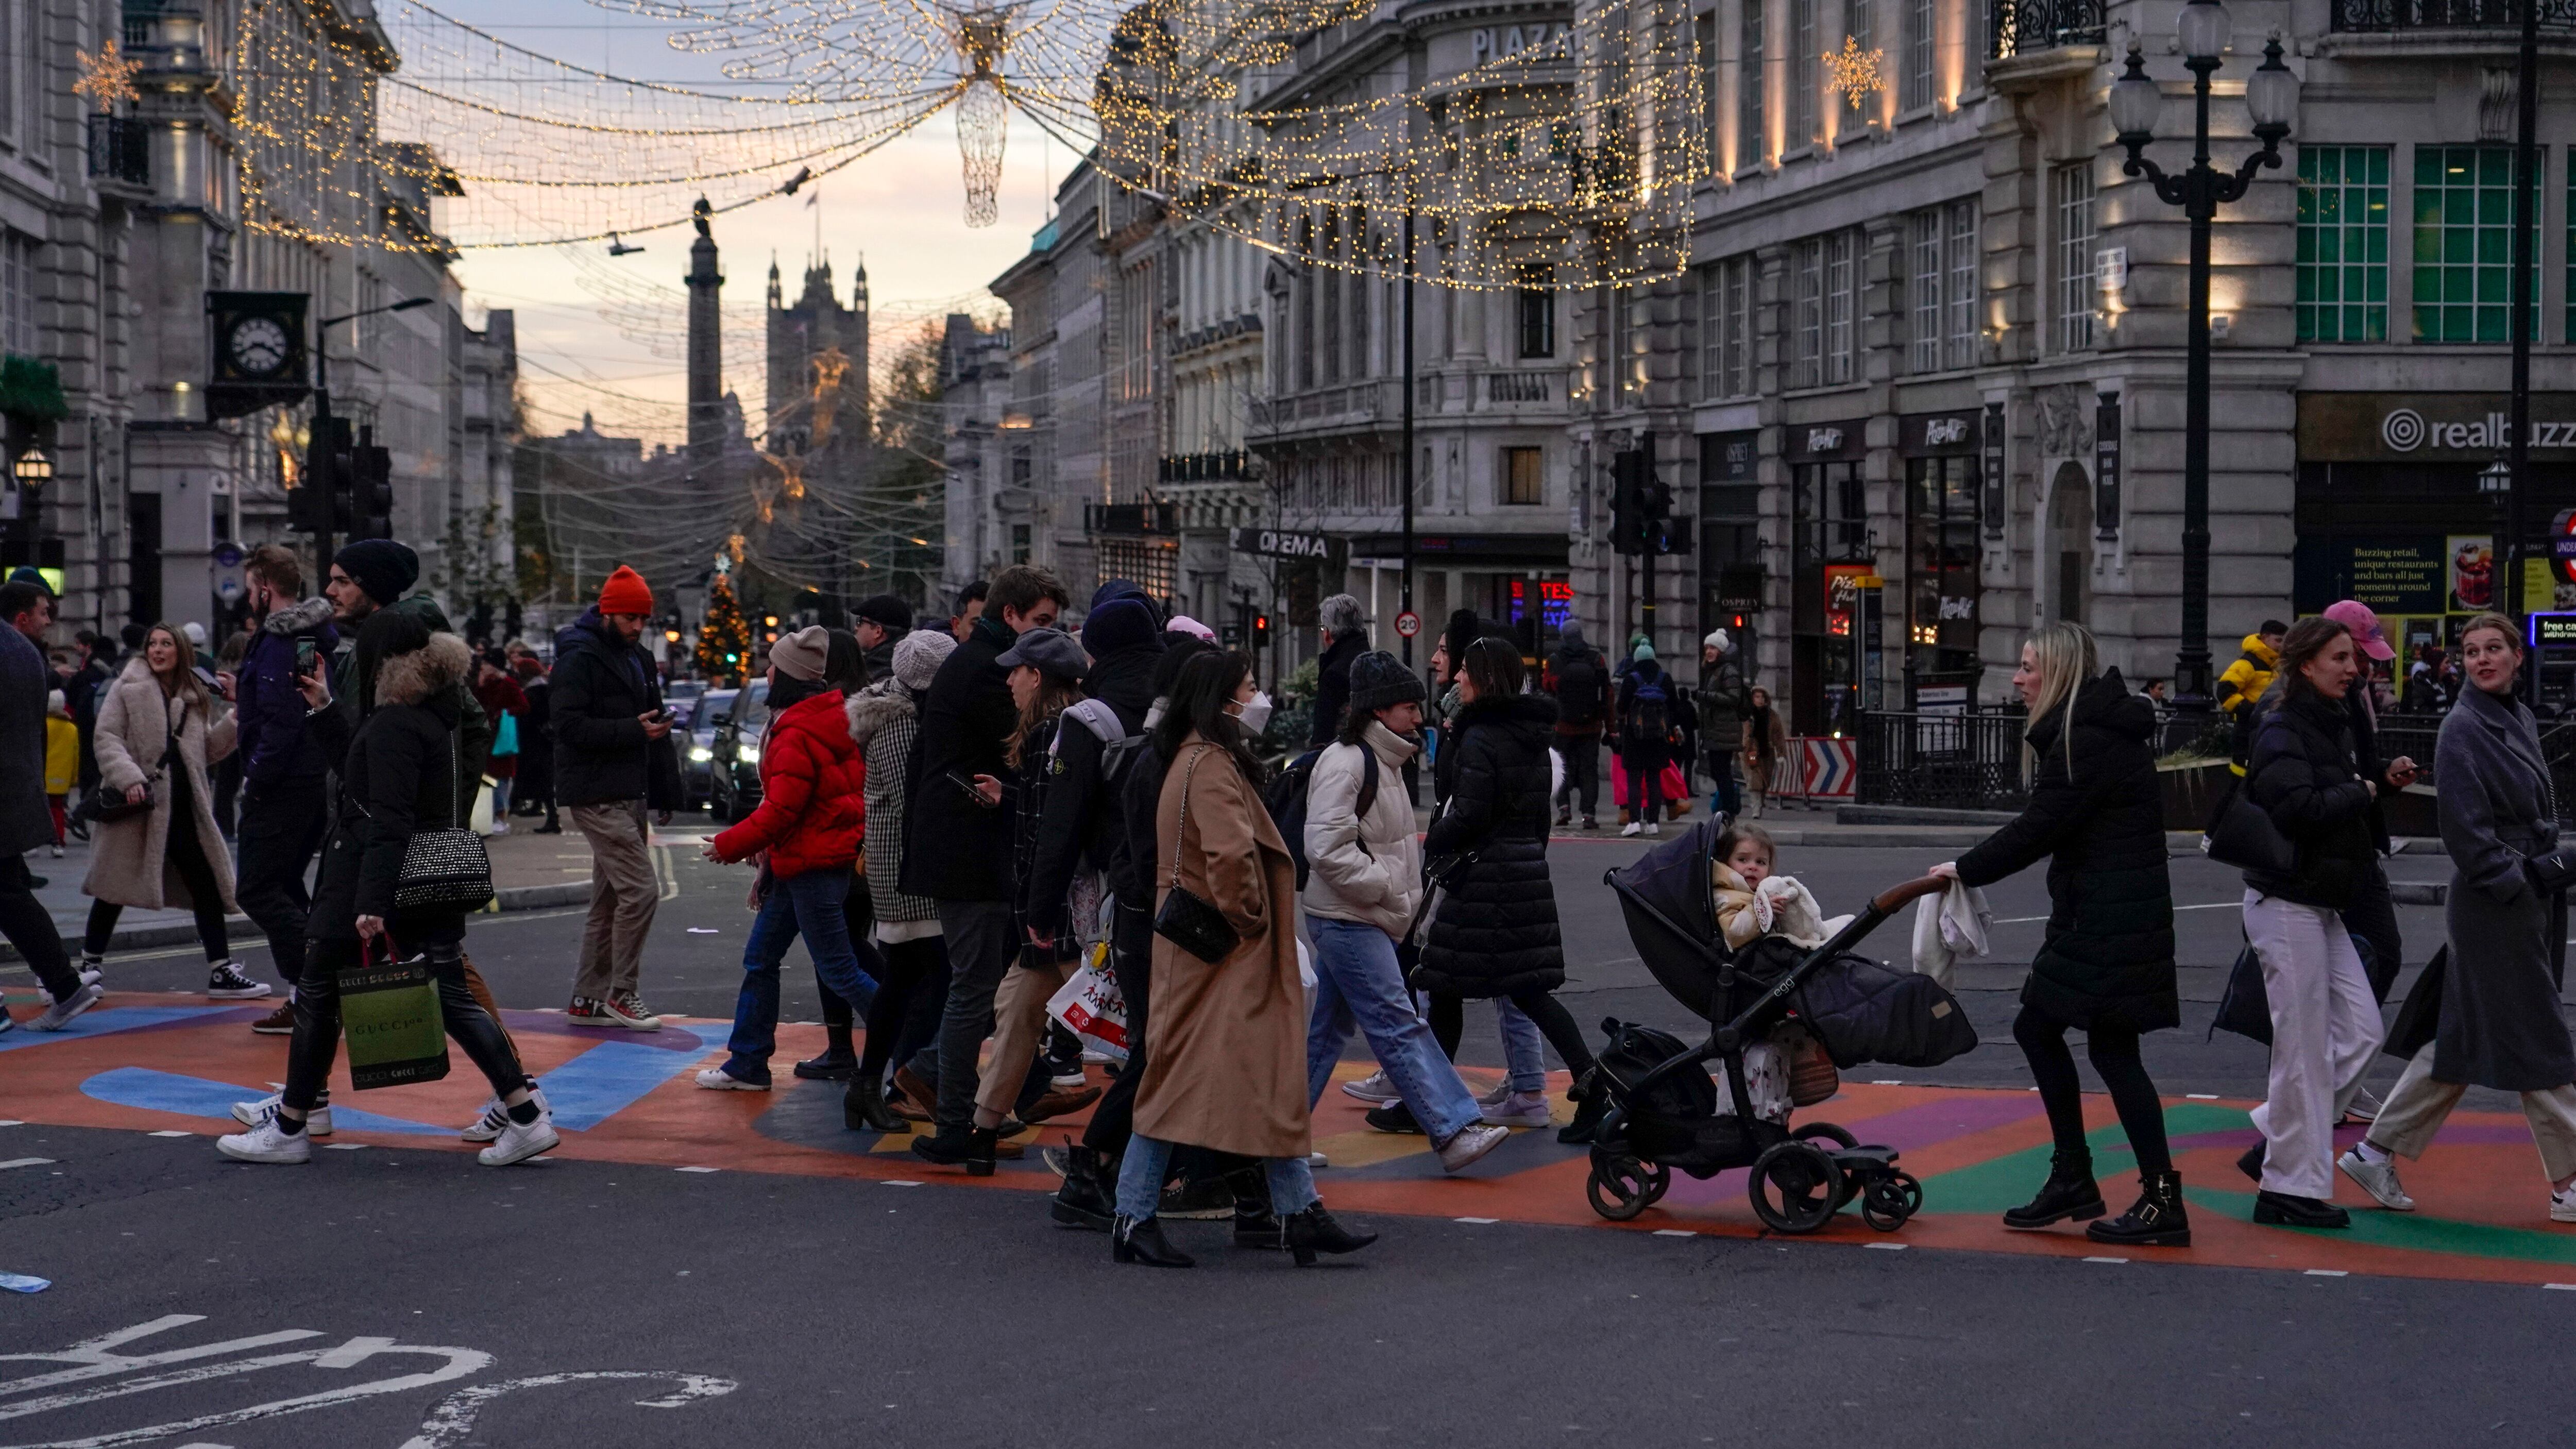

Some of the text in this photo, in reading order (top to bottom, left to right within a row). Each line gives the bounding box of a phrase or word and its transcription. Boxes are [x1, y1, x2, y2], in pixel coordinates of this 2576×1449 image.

[1471, 23, 1573, 64] PLAZA
[2354, 547, 2420, 559] Buzzing retail,
[2354, 560, 2439, 570] unique restaurants
[2354, 570, 2425, 581] and bars all just
[2397, 582, 2431, 592] around
[2354, 593, 2369, 602] the
[1401, 620, 1417, 630] 20
[2544, 621, 2564, 631] free
[1774, 978, 1795, 998] egg
